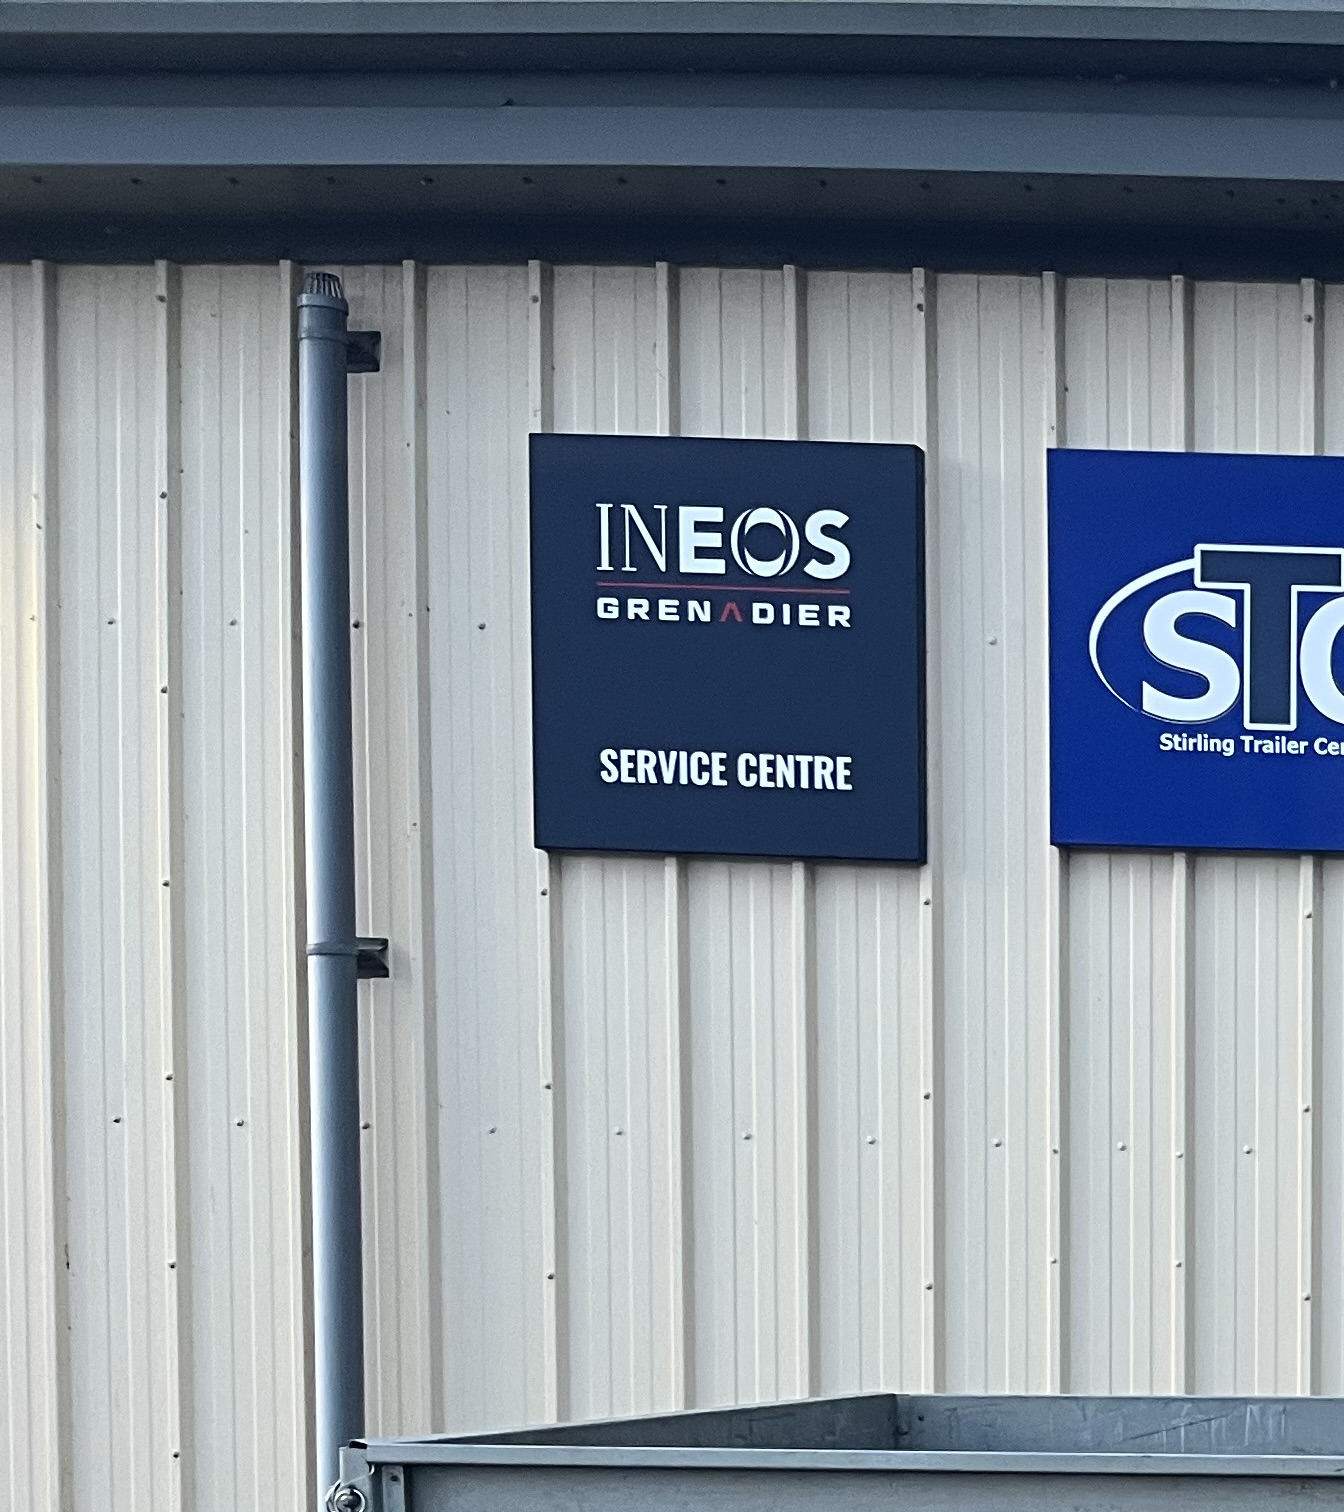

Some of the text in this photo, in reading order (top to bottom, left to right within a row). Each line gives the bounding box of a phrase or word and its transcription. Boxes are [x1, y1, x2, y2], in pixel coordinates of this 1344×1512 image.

[595, 503, 851, 580] INEOS
[596, 597, 851, 628] GRENADIER
[1159, 732, 1235, 757] Stirling
[1239, 735, 1309, 755] Trailer
[600, 748, 853, 791] SERVICE CENTRE
